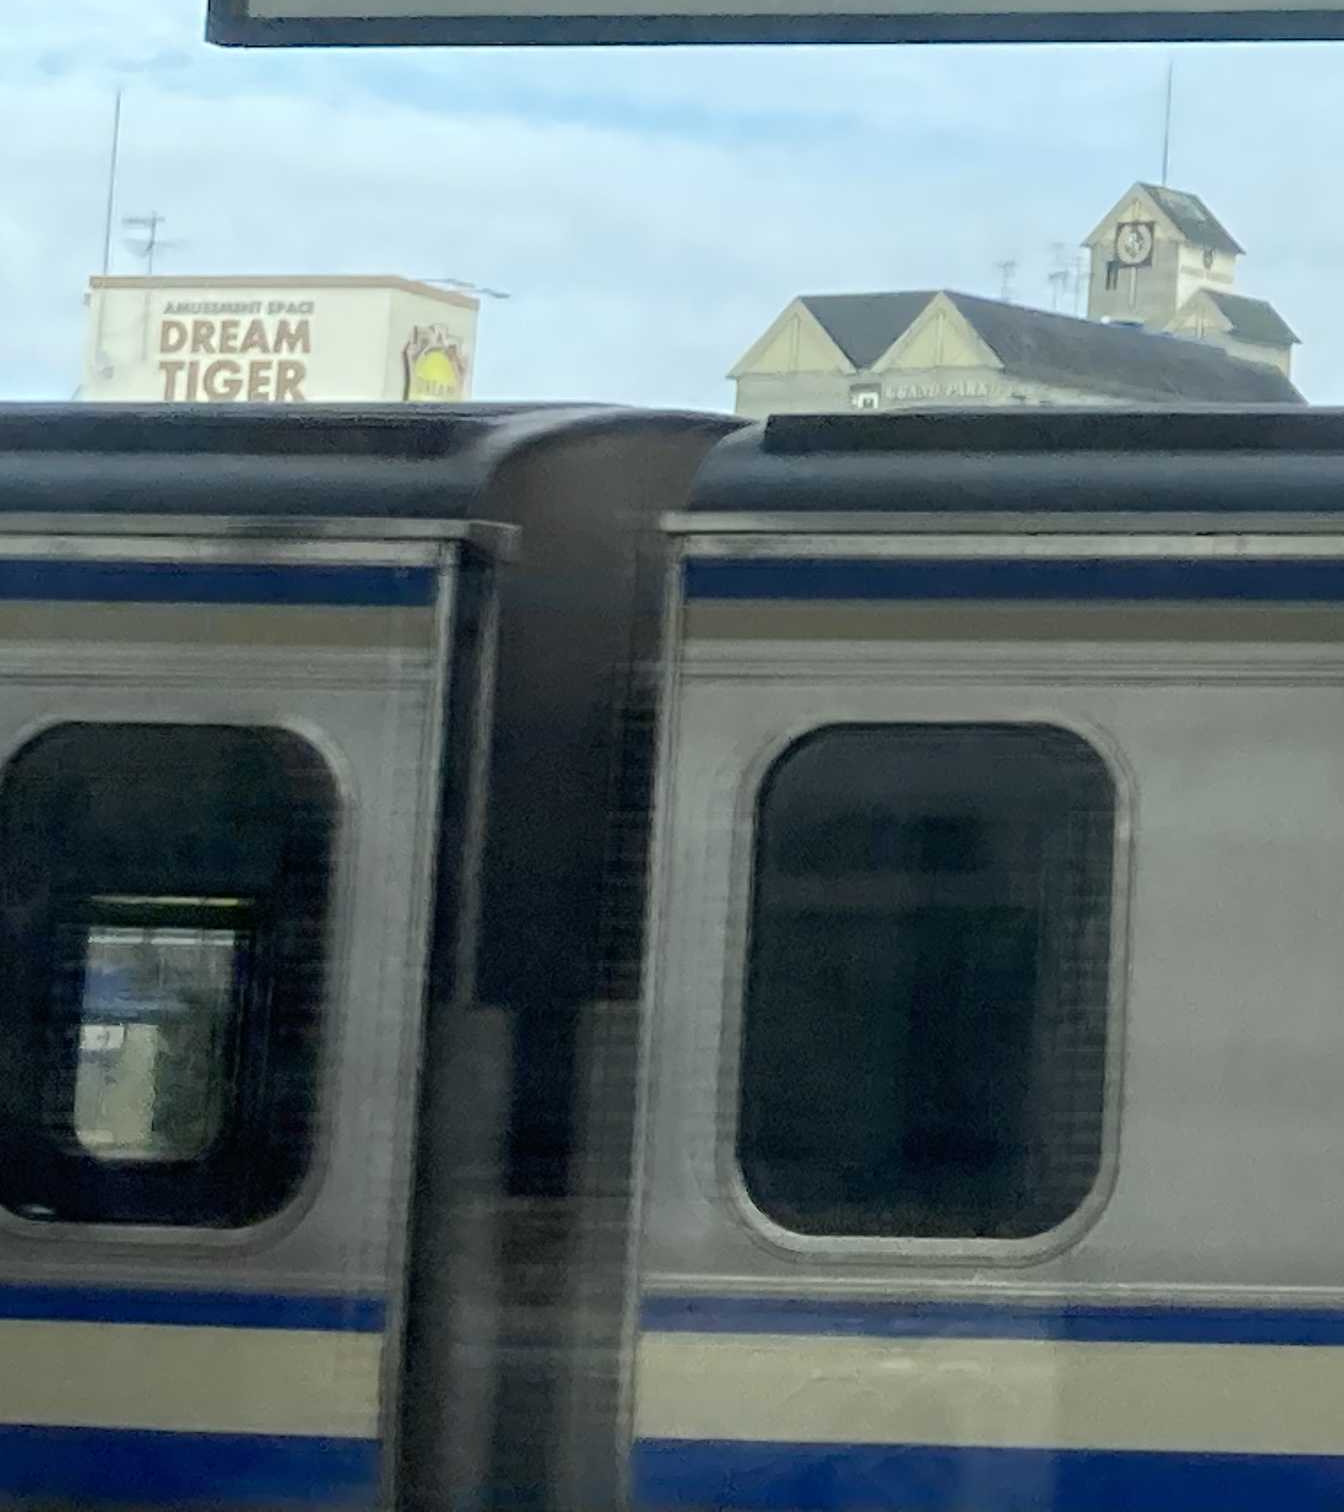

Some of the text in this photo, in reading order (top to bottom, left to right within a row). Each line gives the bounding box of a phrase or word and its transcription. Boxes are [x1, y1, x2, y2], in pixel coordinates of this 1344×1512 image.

[267, 301, 315, 314] SPACE
[159, 320, 311, 354] DREAM
[159, 359, 307, 402] TIGER
